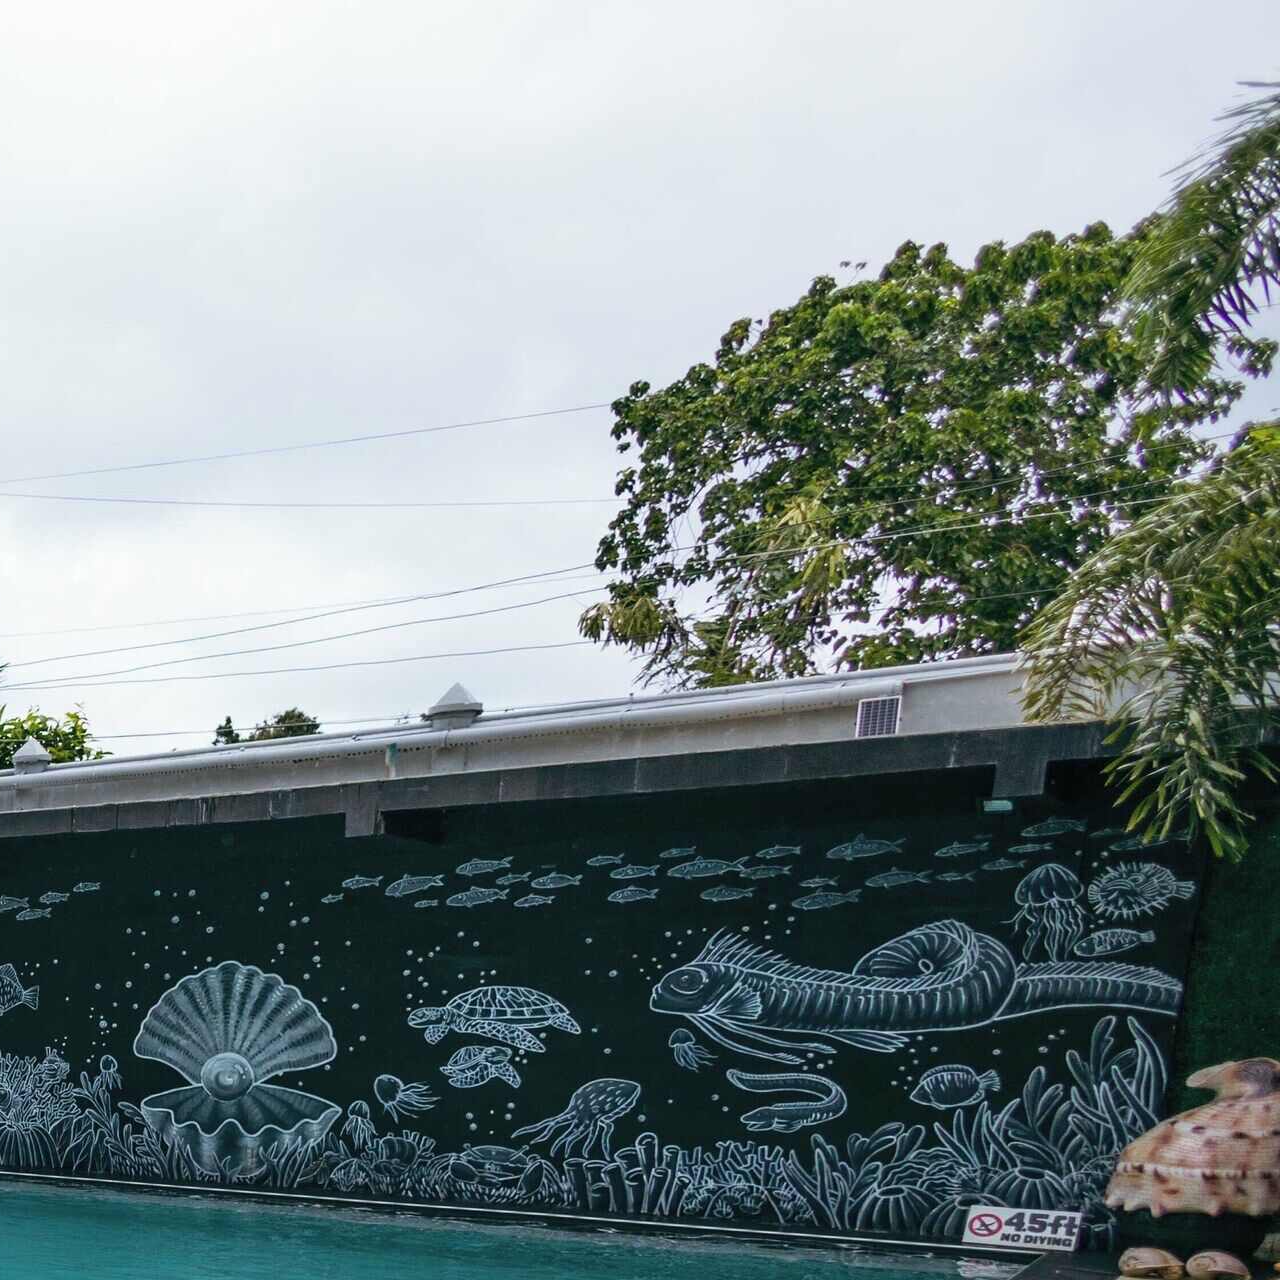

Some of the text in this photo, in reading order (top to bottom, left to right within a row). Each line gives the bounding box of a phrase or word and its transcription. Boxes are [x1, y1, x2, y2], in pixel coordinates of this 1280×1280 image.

[1004, 1212, 1079, 1236] 4.5ft
[1000, 1233, 1073, 1247] NO DIVING
